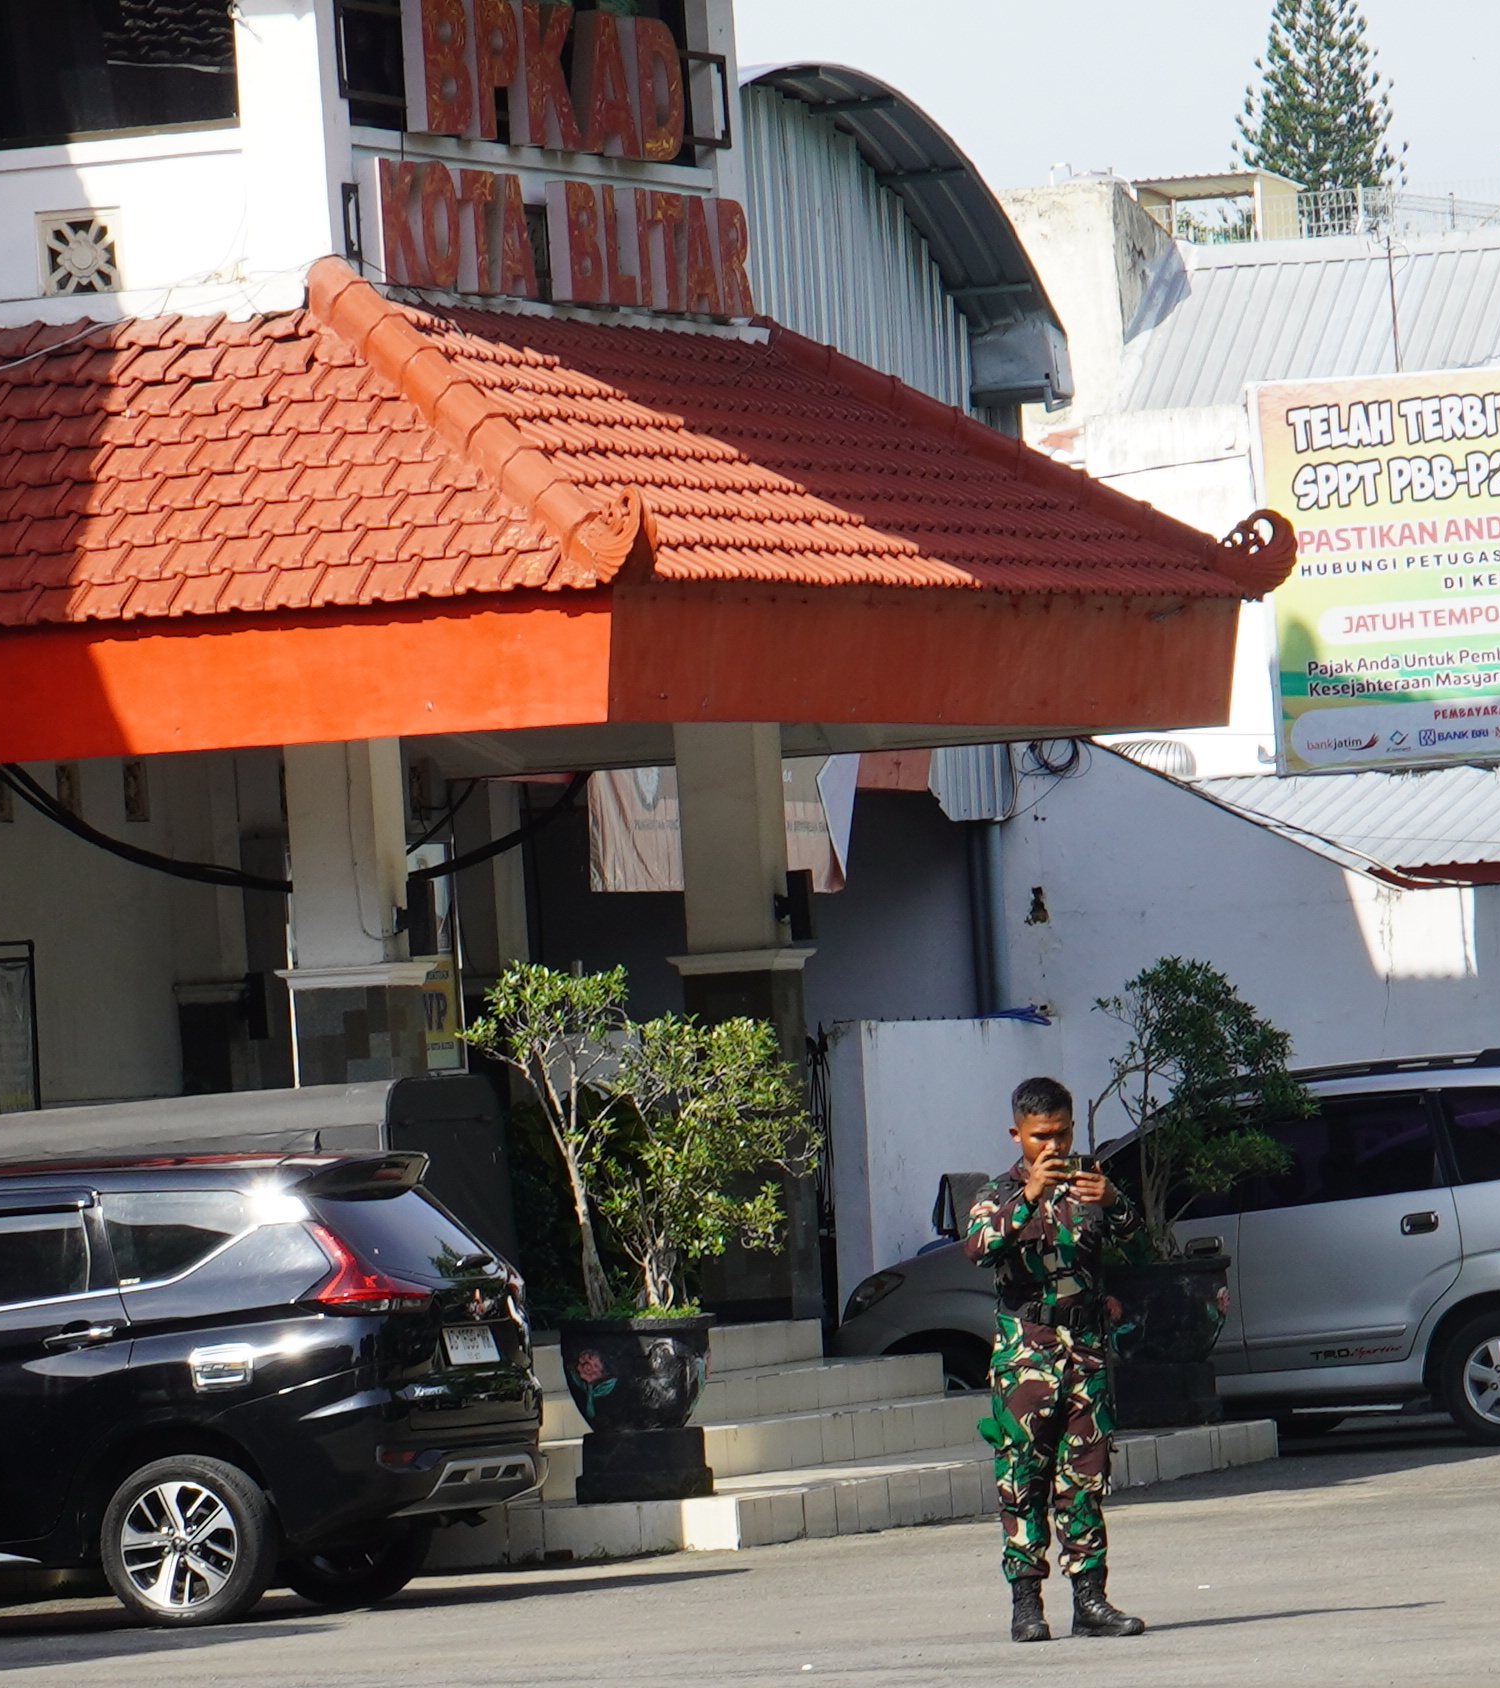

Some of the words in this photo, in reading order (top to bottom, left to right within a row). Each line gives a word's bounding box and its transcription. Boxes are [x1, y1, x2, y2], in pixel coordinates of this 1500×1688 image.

[421, 0, 686, 161] BPKAD
[379, 157, 539, 298] KOTA
[565, 180, 755, 317] BLITAR
[1286, 400, 1395, 454] TELAH
[1292, 458, 1382, 511] SPPT
[1300, 520, 1438, 554] PASTIKAN
[1301, 558, 1397, 577] HUBUNGI
[1444, 576, 1464, 590] DI
[1343, 611, 1415, 634] JATUH
[1419, 605, 1500, 628] TEMPO
[1308, 660, 1354, 679] Pajak
[1357, 656, 1400, 673] Anda
[1404, 651, 1456, 668] Untuk
[1309, 676, 1431, 697] Kesejahteraan
[1307, 738, 1363, 751] bankjatim
[1438, 731, 1469, 742] BANK
[1471, 729, 1489, 738] BRI
[1310, 1349, 1349, 1361] TRD
